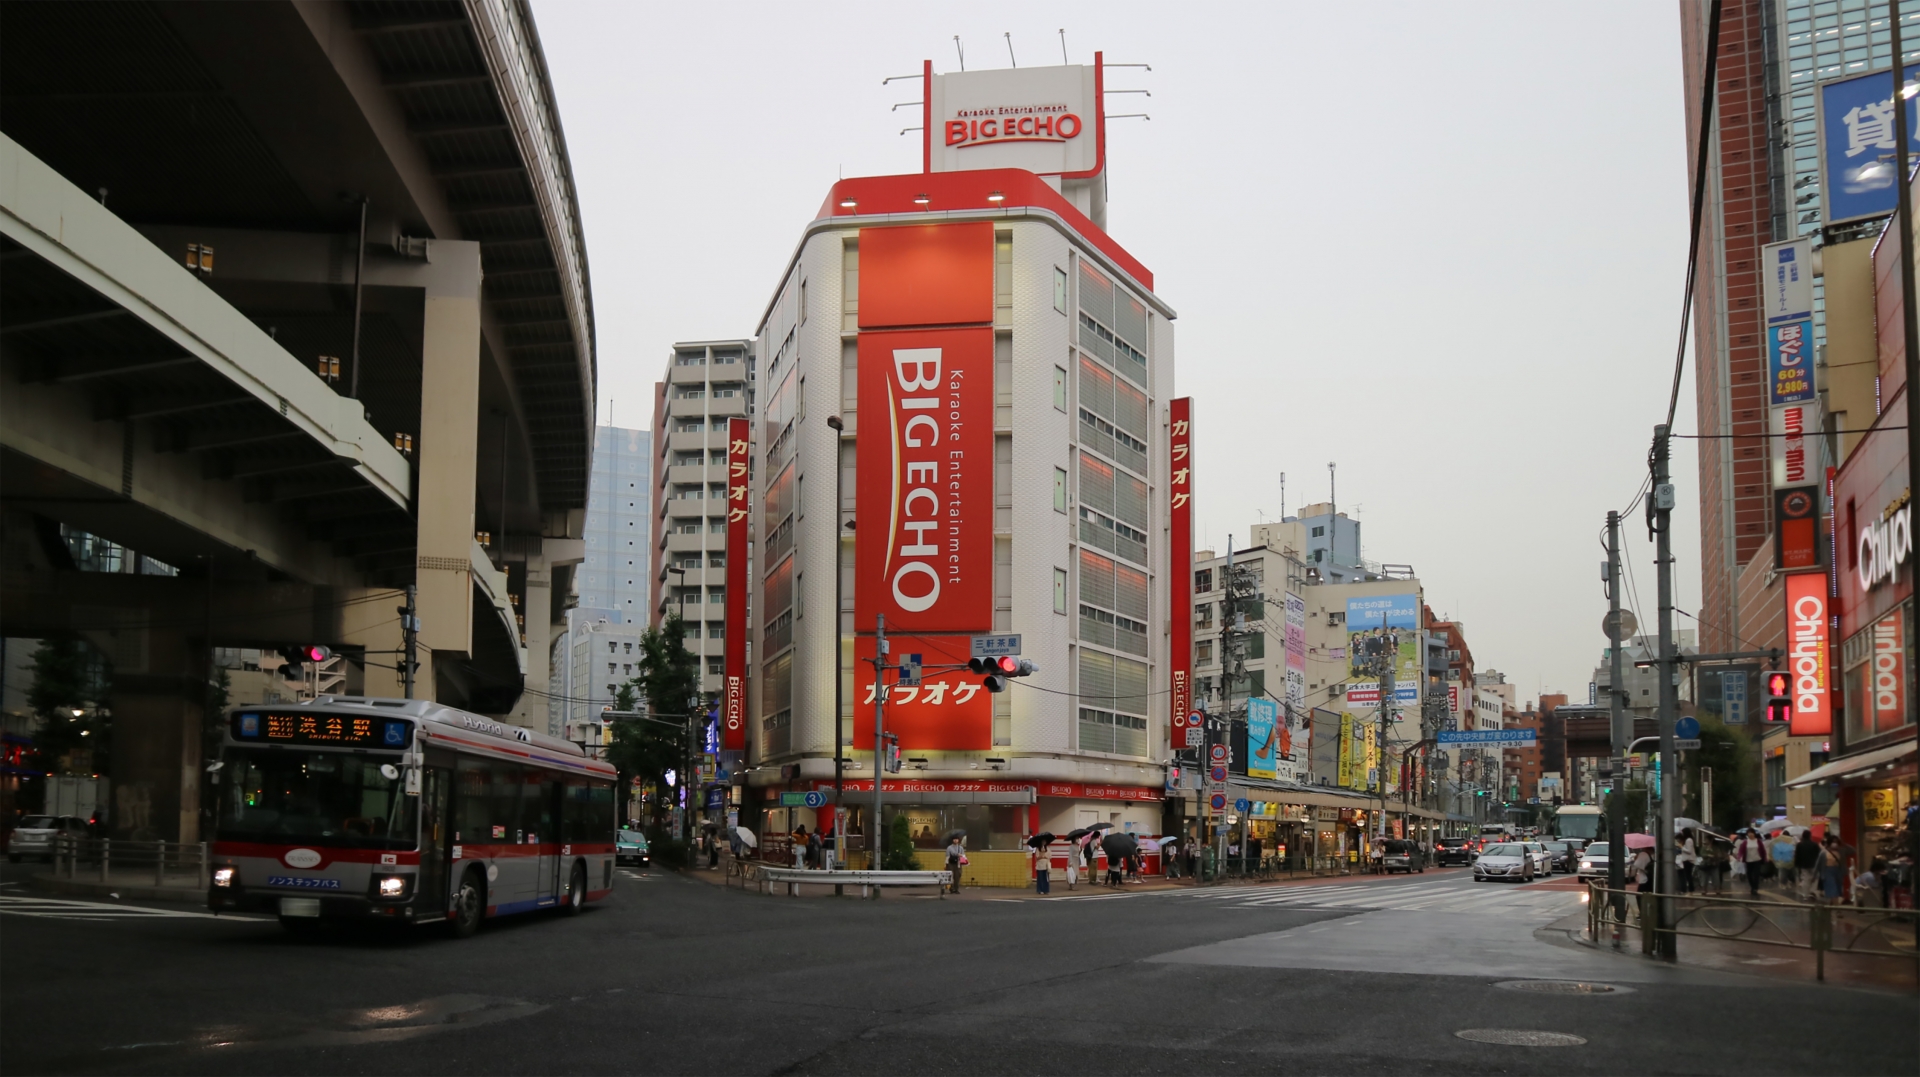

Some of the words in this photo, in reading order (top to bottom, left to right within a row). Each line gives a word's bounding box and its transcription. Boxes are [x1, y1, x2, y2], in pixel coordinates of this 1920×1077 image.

[957, 108, 995, 117] Karaoke
[998, 104, 1068, 115] Entertainment
[945, 119, 997, 147] BIG
[1004, 113, 1082, 139] ECHO
[1777, 325, 1803, 367] ほぐし
[1778, 369, 1805, 380] 60分
[892, 347, 942, 448] BIG
[1777, 380, 1809, 395] 2,980円
[950, 369, 964, 442] Karaoke
[1171, 418, 1189, 509] カラオケ
[728, 438, 747, 523] カラオケ
[948, 450, 964, 584] Entertainment
[892, 461, 941, 612] ECHO
[1858, 502, 1913, 592] Chiyo
[975, 636, 1017, 648] 三軒茶屋
[1790, 596, 1825, 713] Chiyoda
[728, 676, 740, 698] BIG
[1173, 670, 1185, 693] BIG
[863, 681, 981, 706] カラオケ
[728, 699, 740, 730] ECHO
[1173, 695, 1185, 727] ECHO
[299, 716, 371, 737] 渋谷駅
[463, 716, 502, 735] Hybrid
[1440, 730, 1533, 742] この先中央線が変わります
[1214, 748, 1223, 756] 40
[868, 784, 895, 792] カオケ
[903, 784, 920, 792] BIG
[921, 784, 945, 792] ECHO
[953, 784, 981, 792] カラオケ
[989, 784, 1006, 792] BIG
[1006, 784, 1030, 792] ECHO
[1051, 785, 1060, 794] BIG
[808, 793, 817, 805] 3
[269, 877, 339, 888] ノンステップバス
